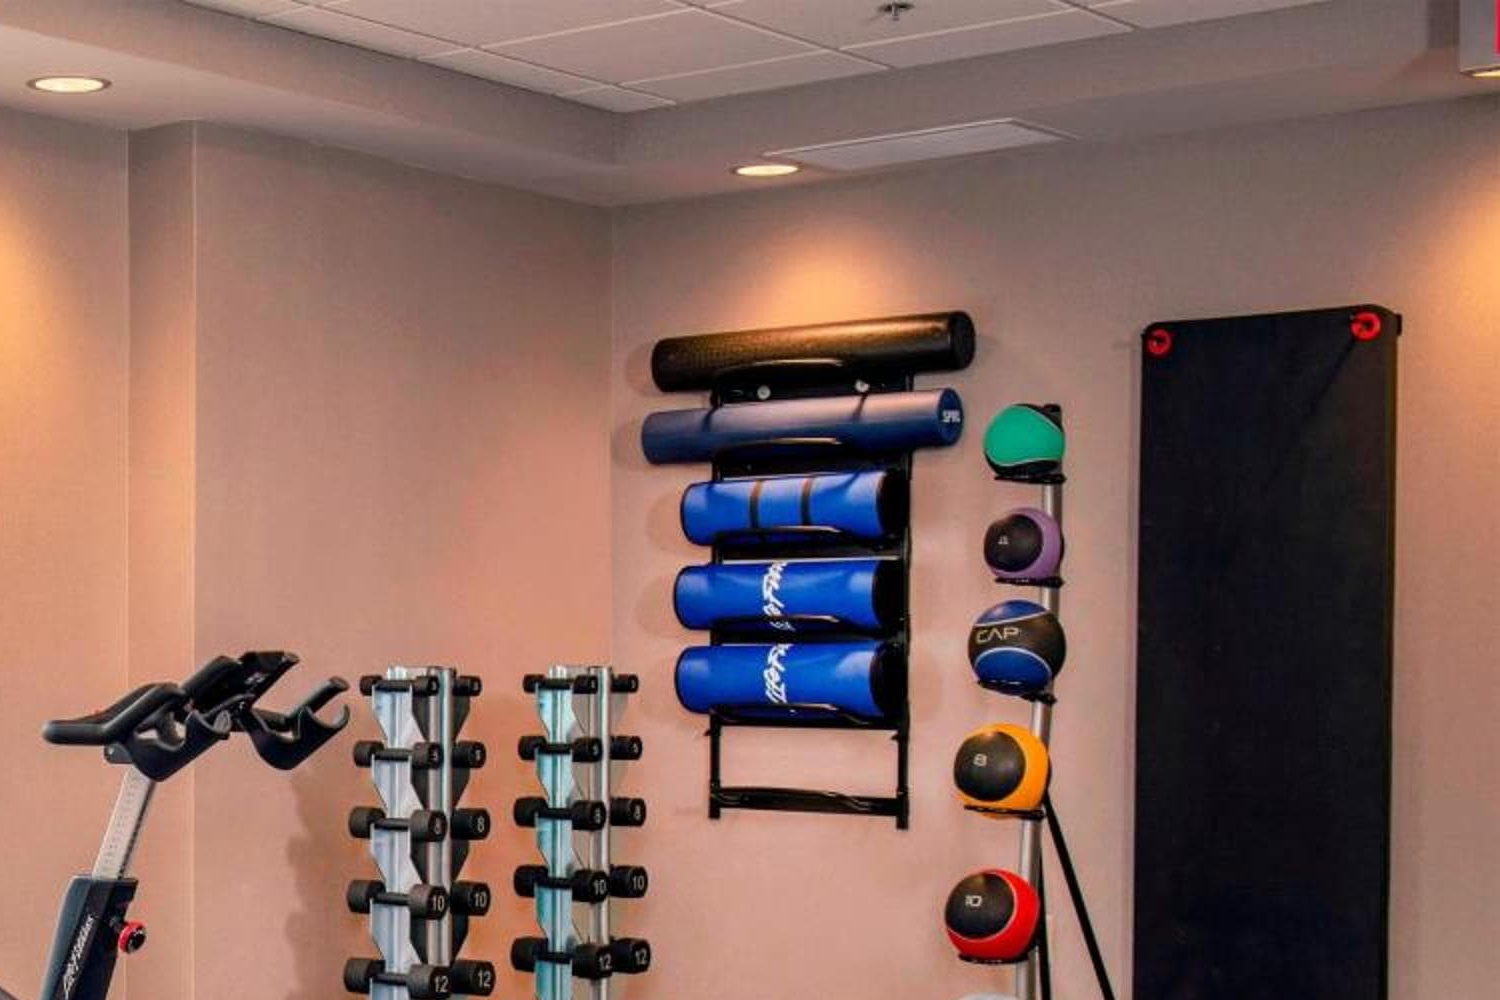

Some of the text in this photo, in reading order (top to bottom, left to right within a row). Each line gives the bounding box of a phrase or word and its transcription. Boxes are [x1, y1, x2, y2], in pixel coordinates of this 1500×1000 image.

[975, 627, 1021, 643] CAP
[973, 753, 987, 767] 8
[477, 816, 485, 833] 8
[593, 879, 607, 895] 10
[632, 875, 645, 890] 10
[432, 895, 445, 911] 10
[474, 892, 487, 908] 10
[965, 895, 983, 908] 10
[599, 954, 612, 971] 12
[635, 949, 647, 965] 12
[434, 976, 449, 993] 12
[477, 971, 491, 988] 12
